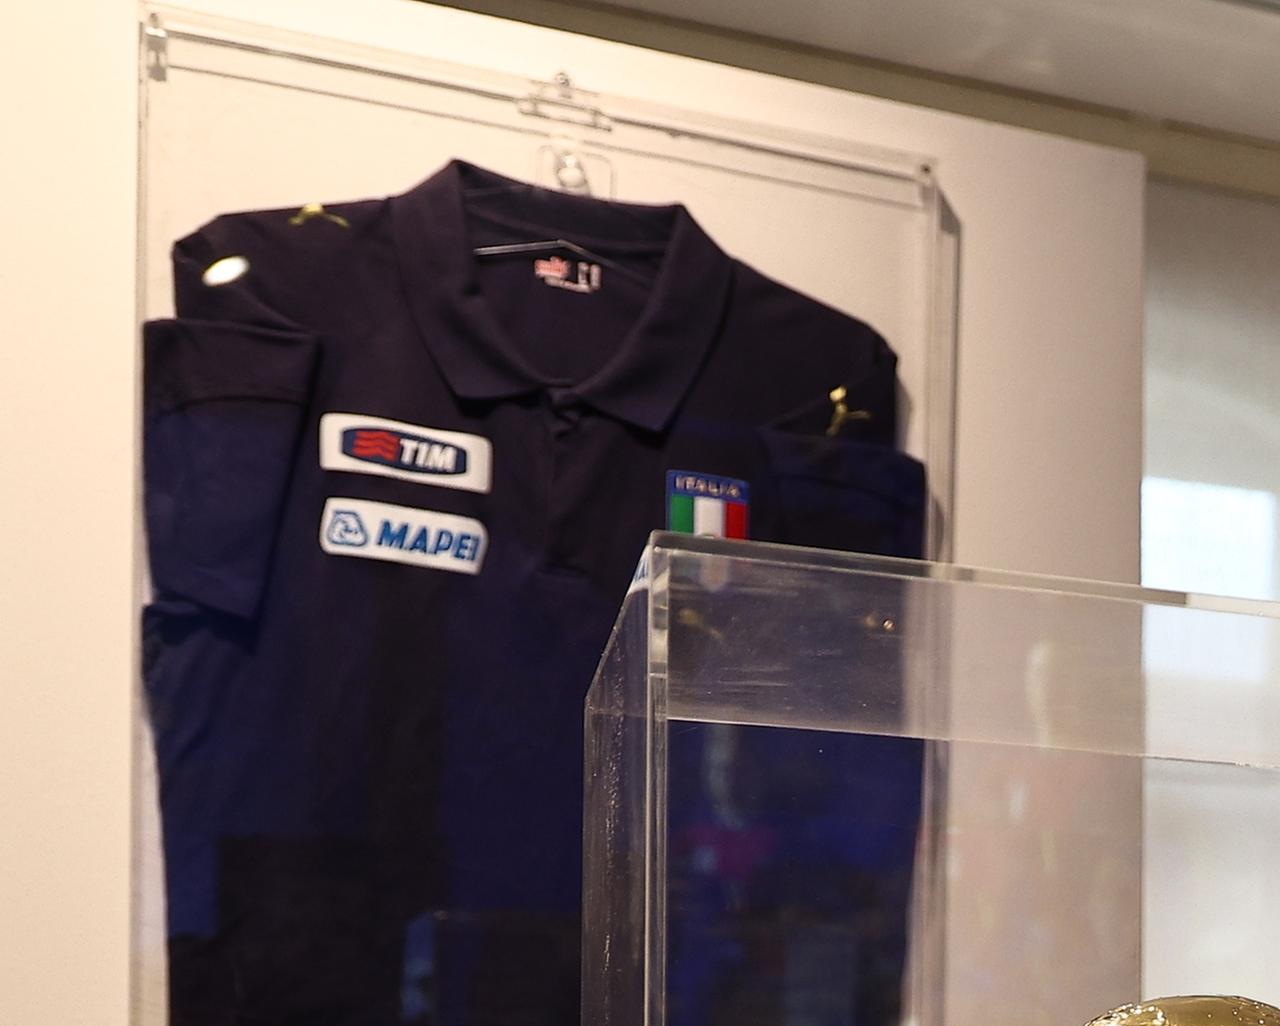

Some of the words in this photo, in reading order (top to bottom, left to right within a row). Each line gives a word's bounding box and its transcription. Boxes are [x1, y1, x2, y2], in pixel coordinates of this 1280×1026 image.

[399, 438, 458, 474] TIM
[675, 474, 741, 498] ITALIA
[376, 518, 480, 562] MAPEI
